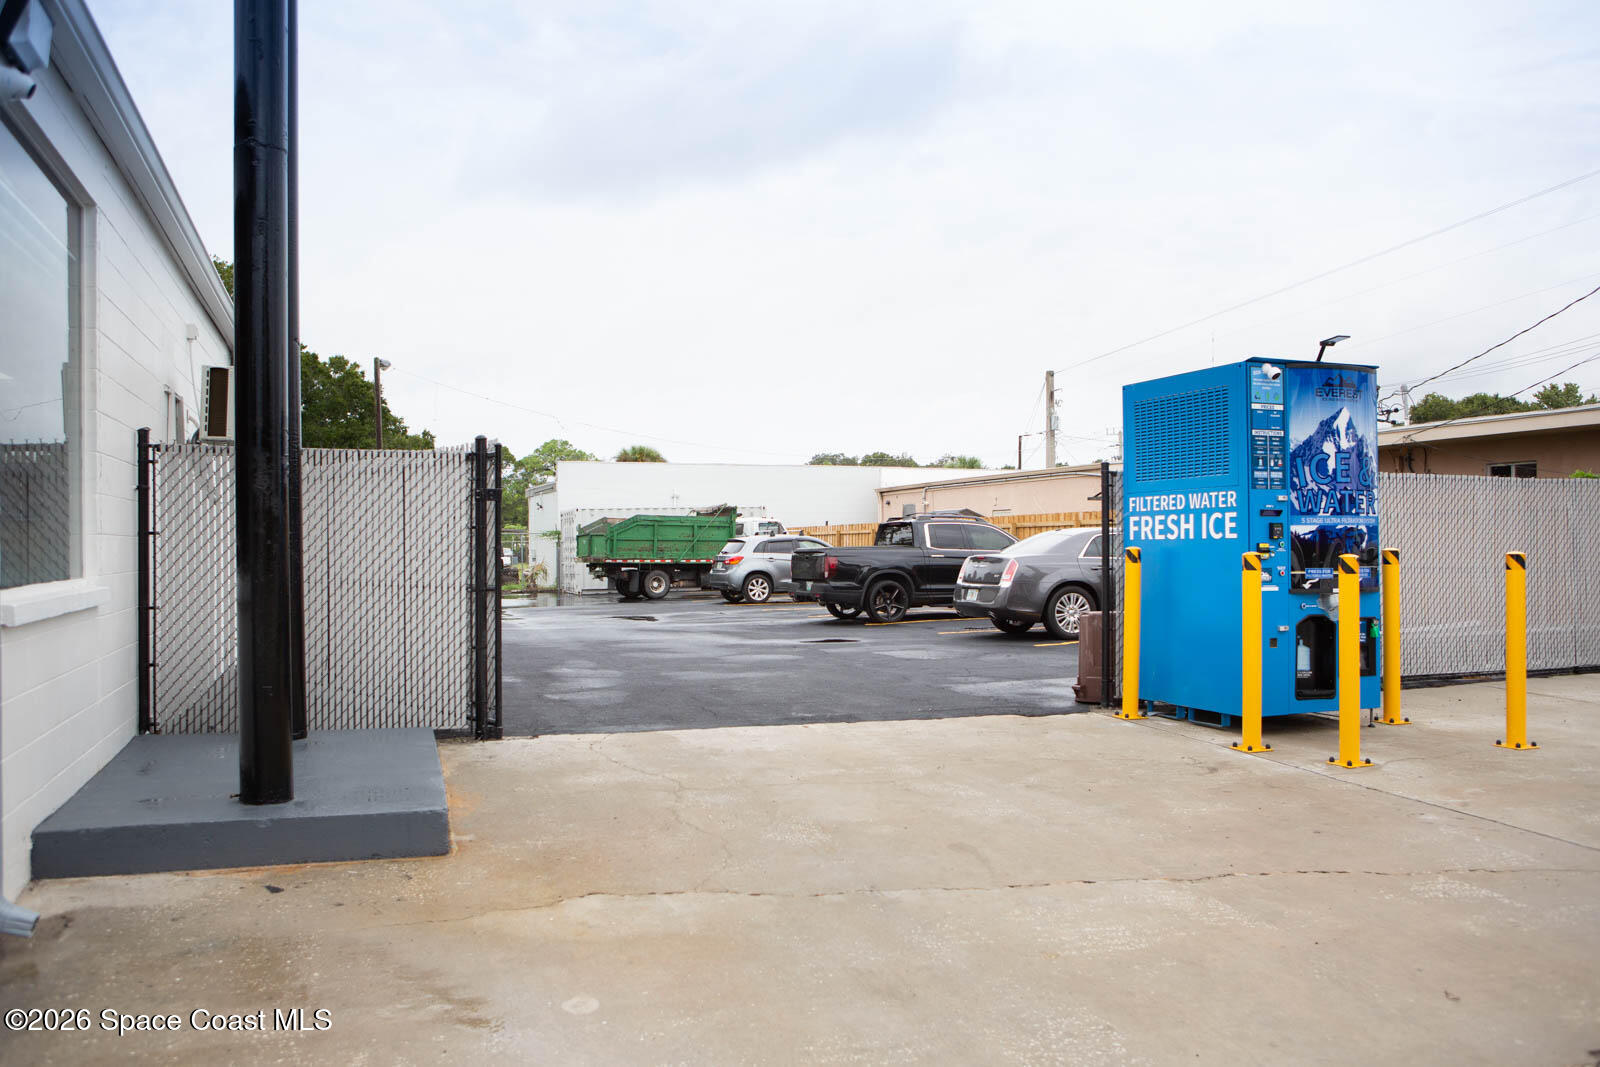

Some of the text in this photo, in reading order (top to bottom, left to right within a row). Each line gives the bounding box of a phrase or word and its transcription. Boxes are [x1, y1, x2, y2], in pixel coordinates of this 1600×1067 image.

[1315, 387, 1362, 399] EVEREST
[1295, 452, 1351, 488] ICE
[1359, 456, 1372, 487] &
[1129, 490, 1237, 512] FILTERED WATER
[1297, 489, 1376, 514] WATER
[1129, 512, 1238, 540] FRESH ICE
